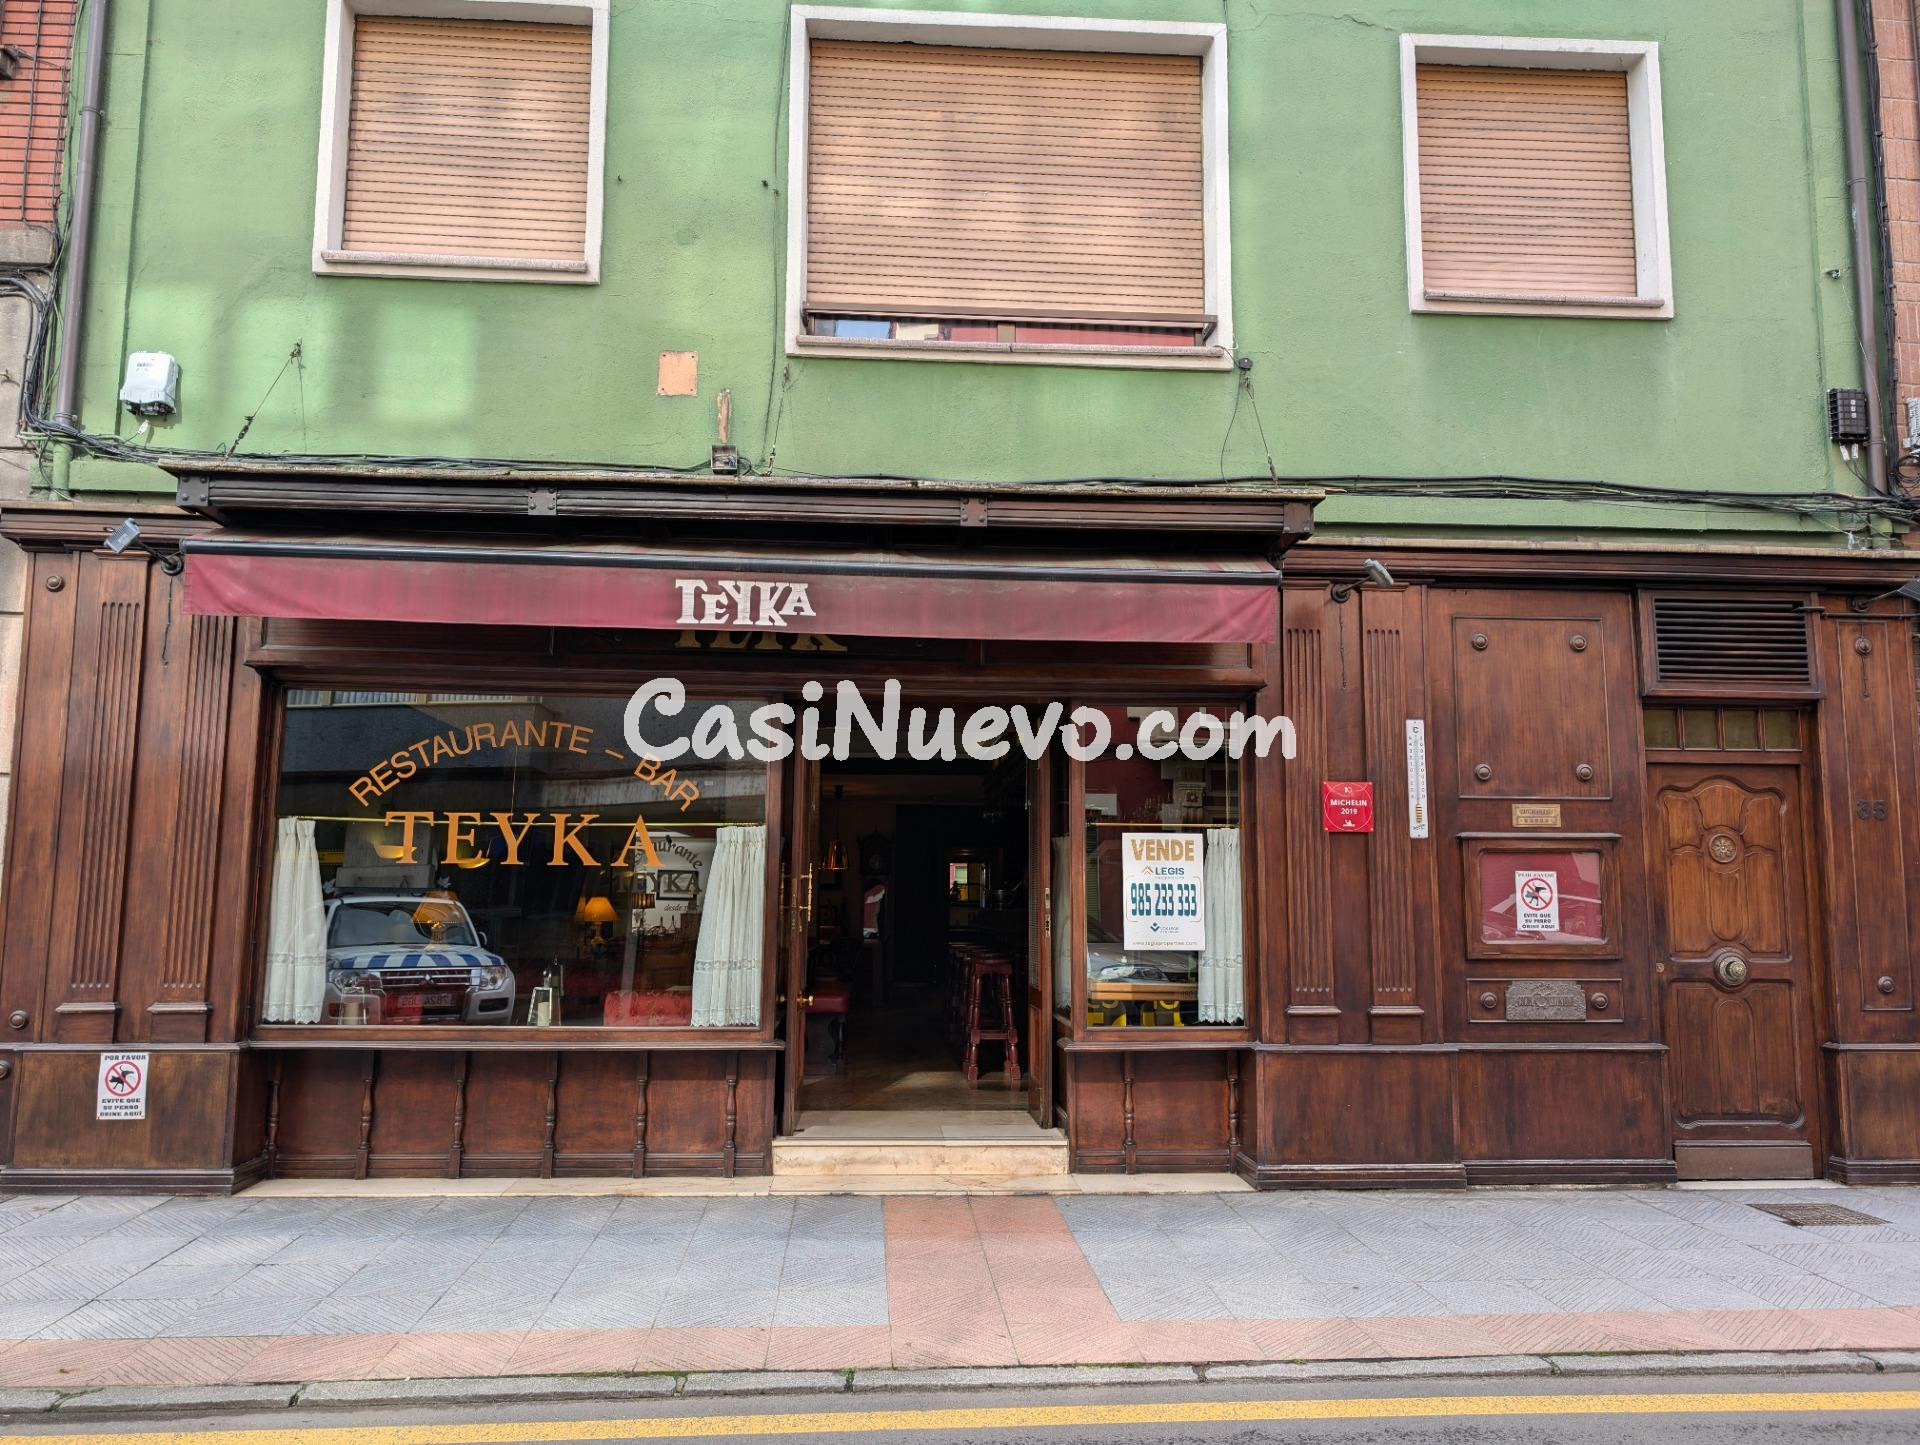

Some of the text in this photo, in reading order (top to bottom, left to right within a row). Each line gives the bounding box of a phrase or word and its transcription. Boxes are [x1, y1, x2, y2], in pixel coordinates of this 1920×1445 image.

[675, 579, 816, 627] TEYKA
[348, 719, 594, 807] RESTAURANTE
[634, 752, 700, 812] BAR
[385, 811, 666, 868] TEYKA
[1131, 839, 1195, 861] VENDE
[1155, 867, 1185, 876] LEGIS
[1131, 883, 1197, 917] 985 233 333
